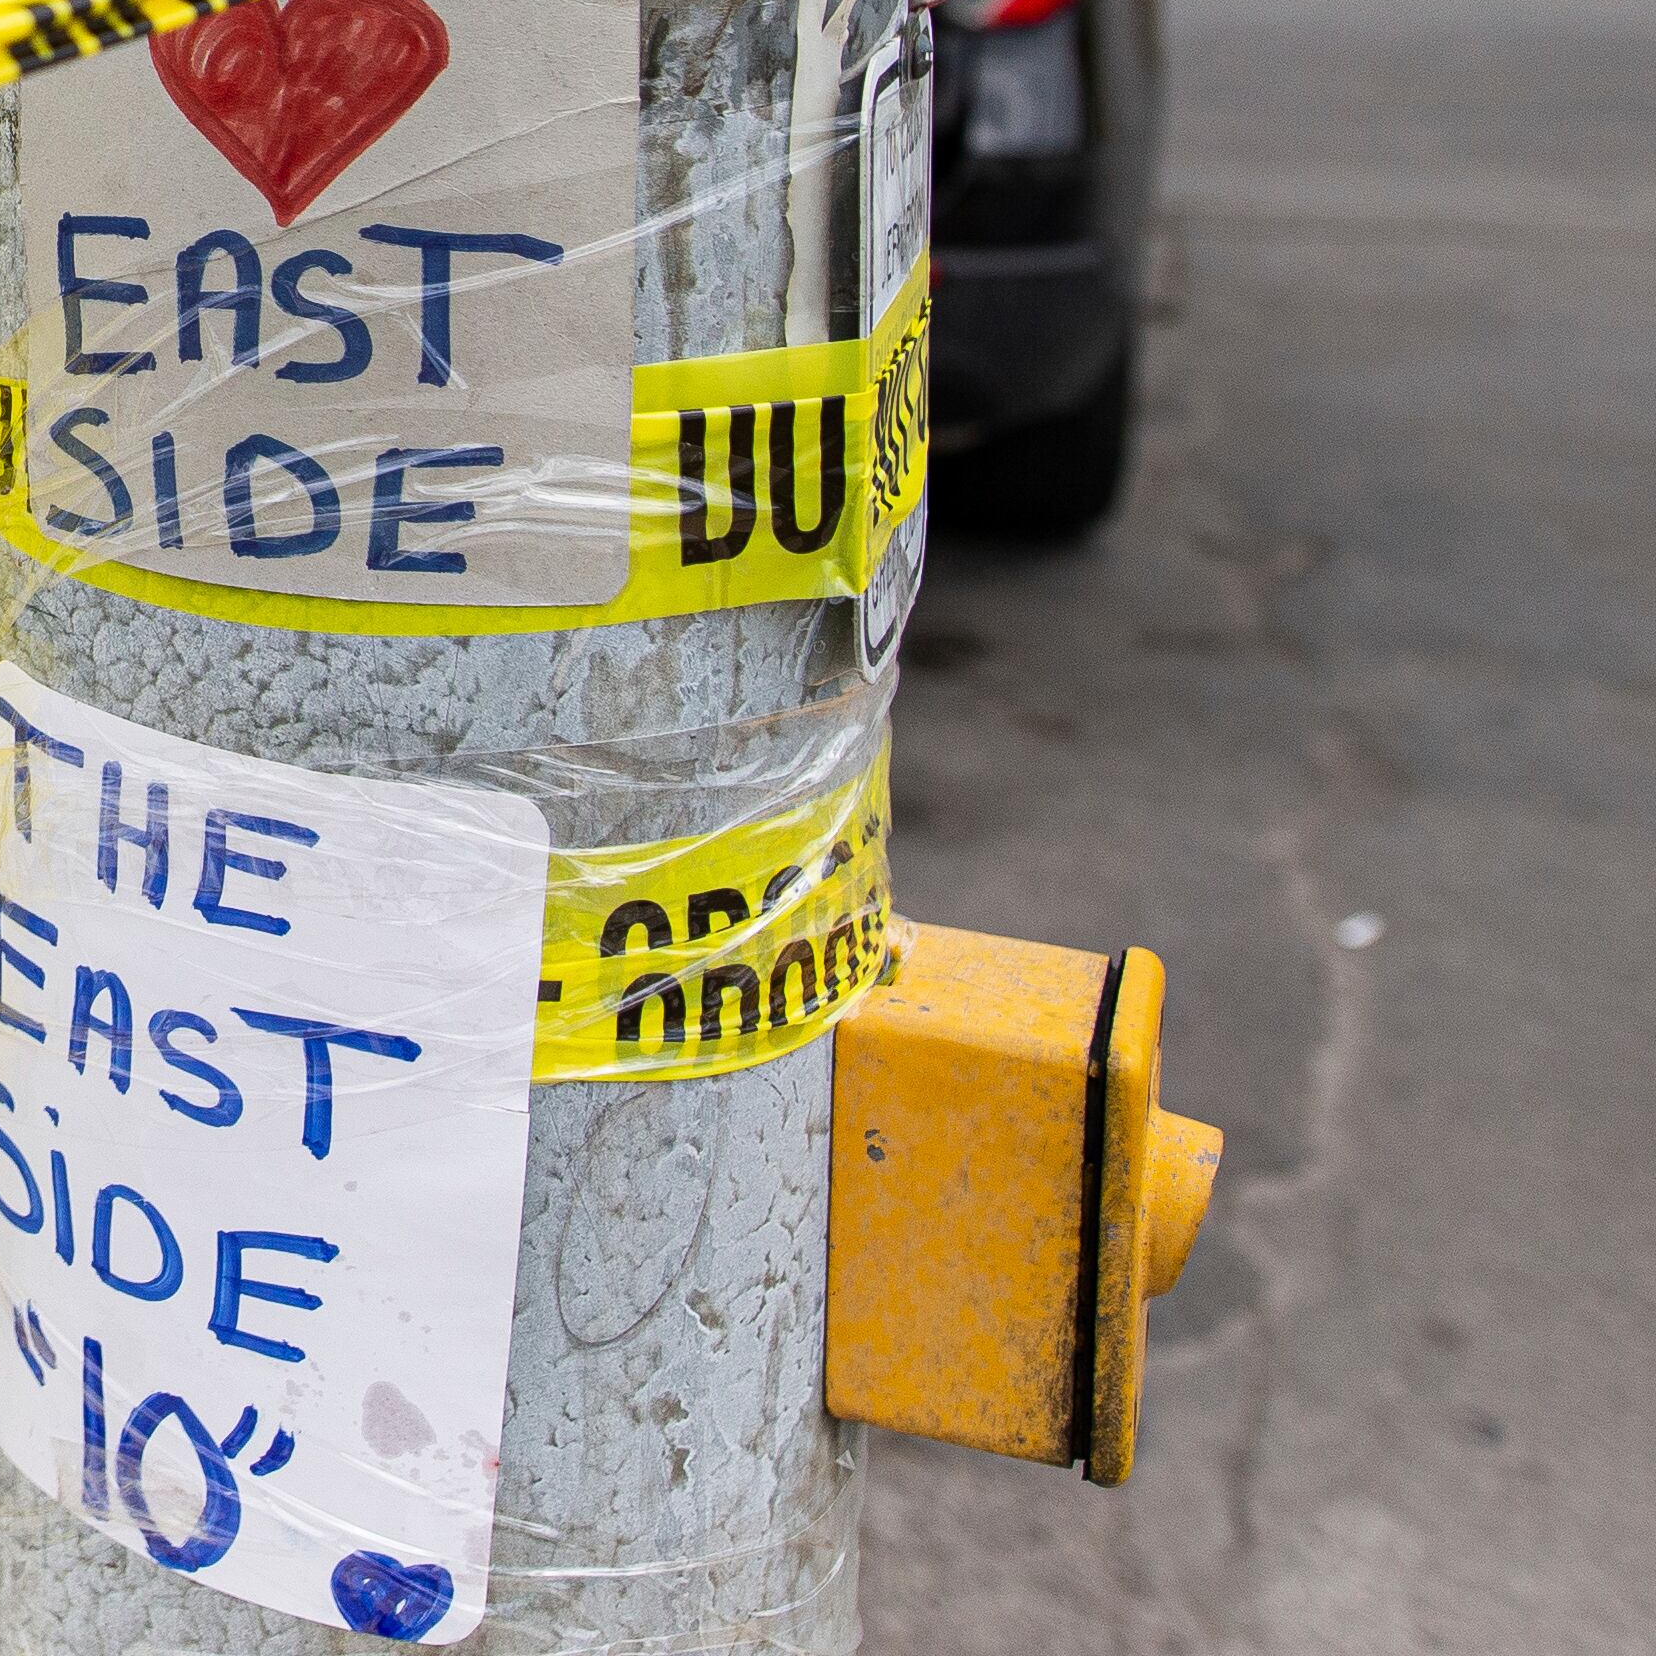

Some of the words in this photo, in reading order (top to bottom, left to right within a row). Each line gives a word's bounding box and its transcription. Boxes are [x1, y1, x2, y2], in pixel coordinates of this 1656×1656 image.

[57, 211, 566, 389] EAST
[47, 406, 505, 574] SIDE
[13, 1300, 296, 1574] "10"
